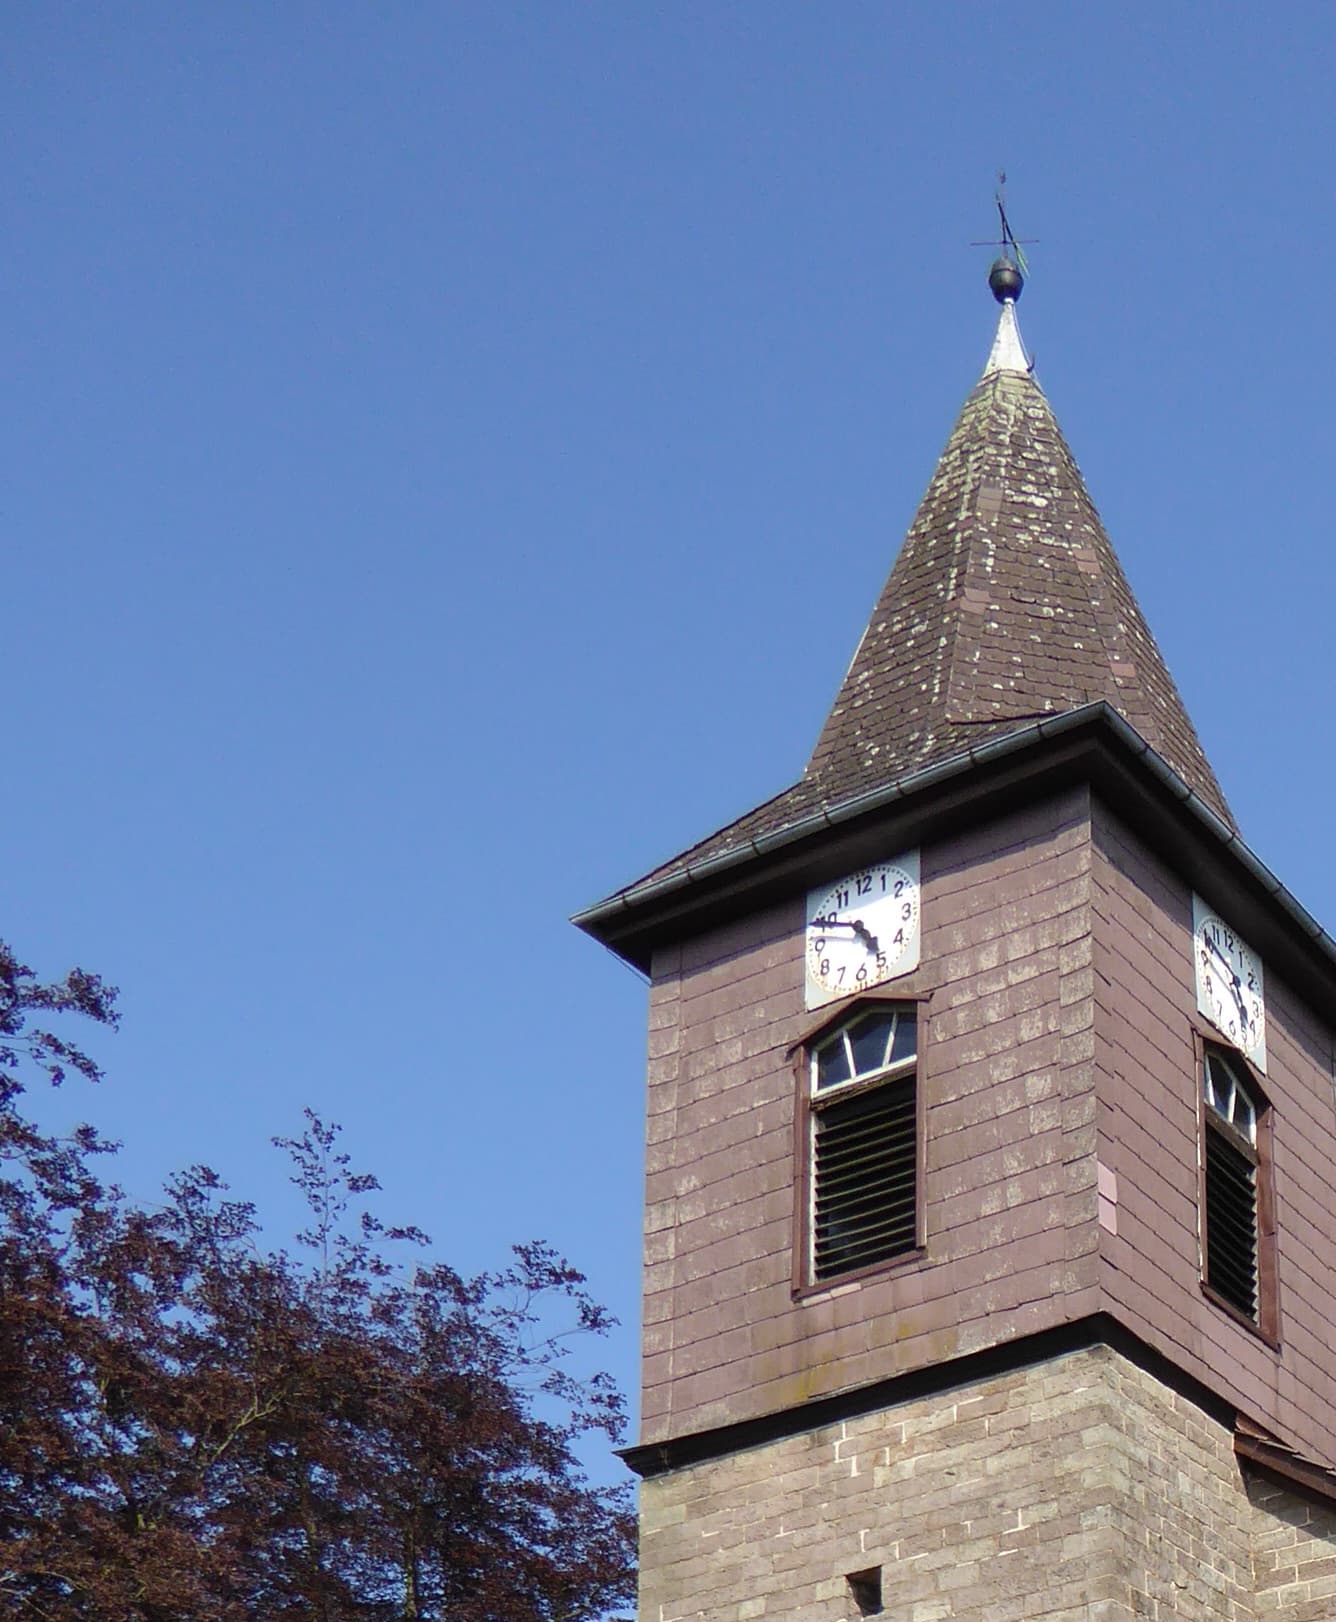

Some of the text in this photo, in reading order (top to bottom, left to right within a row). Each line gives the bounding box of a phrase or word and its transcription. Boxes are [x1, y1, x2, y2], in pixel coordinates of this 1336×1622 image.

[856, 875, 872, 897] 12
[880, 875, 887, 892] 1
[894, 880, 905, 899] 2
[836, 891, 849, 909] 11
[902, 902, 911, 921] 3
[893, 928, 904, 945] 4
[1211, 924, 1221, 946] 11
[1223, 929, 1235, 953] 12
[814, 938, 826, 957] 9
[820, 959, 830, 976] 8
[876, 951, 887, 968] 5
[1238, 951, 1243, 968] 1
[837, 967, 846, 985] 7
[856, 963, 867, 982] 6
[1247, 972, 1256, 991] 2
[1205, 975, 1213, 994] 8
[1216, 1000, 1223, 1018] 7
[1252, 1000, 1259, 1018] 3
[1229, 1020, 1237, 1037] 6
[1249, 1020, 1256, 1037] 4
